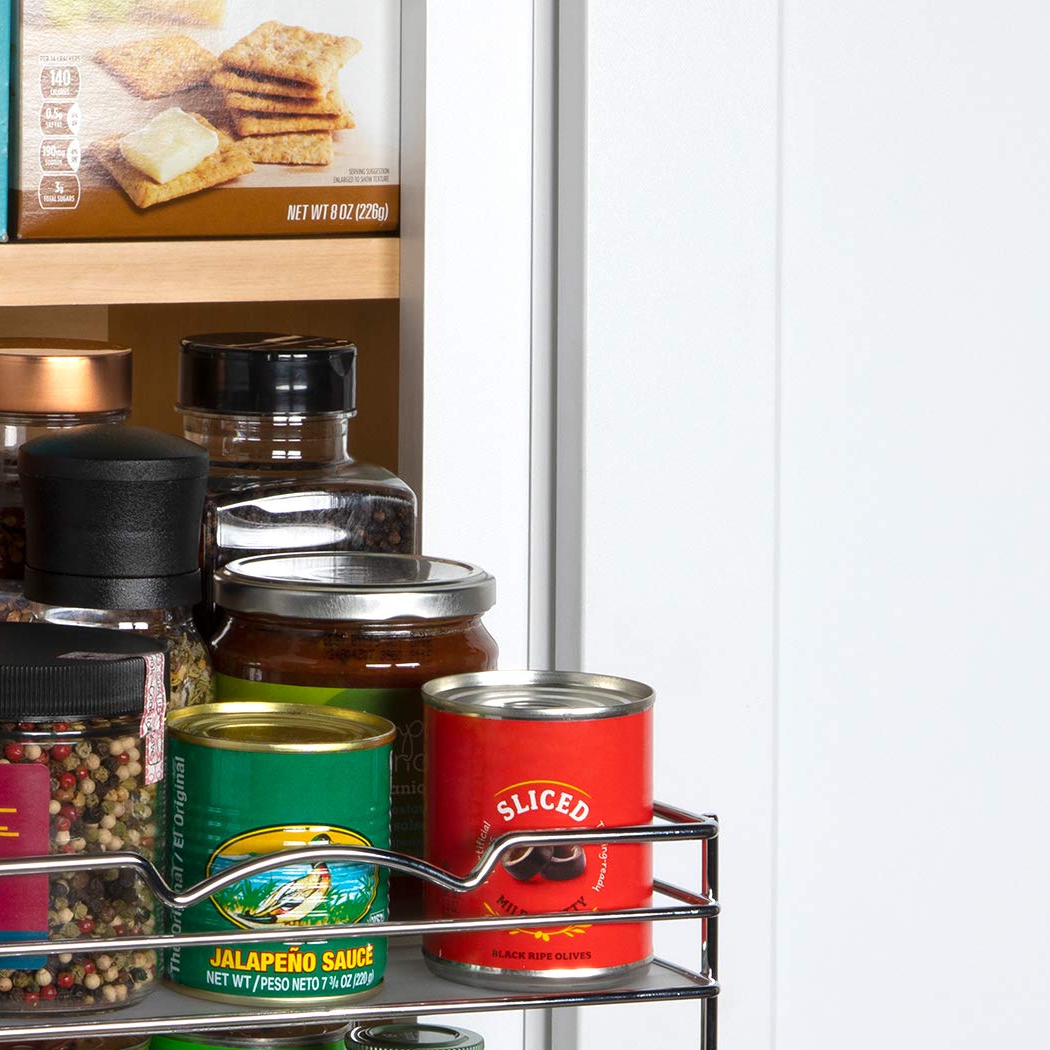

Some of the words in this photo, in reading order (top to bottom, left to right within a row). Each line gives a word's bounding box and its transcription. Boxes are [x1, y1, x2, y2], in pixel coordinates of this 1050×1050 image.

[50, 69, 71, 86] 140
[287, 204, 309, 220] NET
[311, 204, 329, 220] WT
[330, 204, 337, 220] 8
[339, 204, 354, 220] OZ
[355, 203, 389, 222] (226g)
[172, 756, 187, 827] Original
[496, 789, 590, 822] SLICED
[171, 866, 184, 937] Orinal
[210, 945, 316, 973] JALAPEÑO
[322, 944, 374, 972] SAUCE
[492, 950, 525, 960] BLACK
[528, 951, 552, 960] RIPE
[555, 951, 591, 960] OLIVES
[206, 970, 229, 986] NET
[232, 975, 251, 989] WT
[292, 976, 319, 991] NETO
[321, 976, 327, 990] 7
[340, 974, 352, 987] OZ
